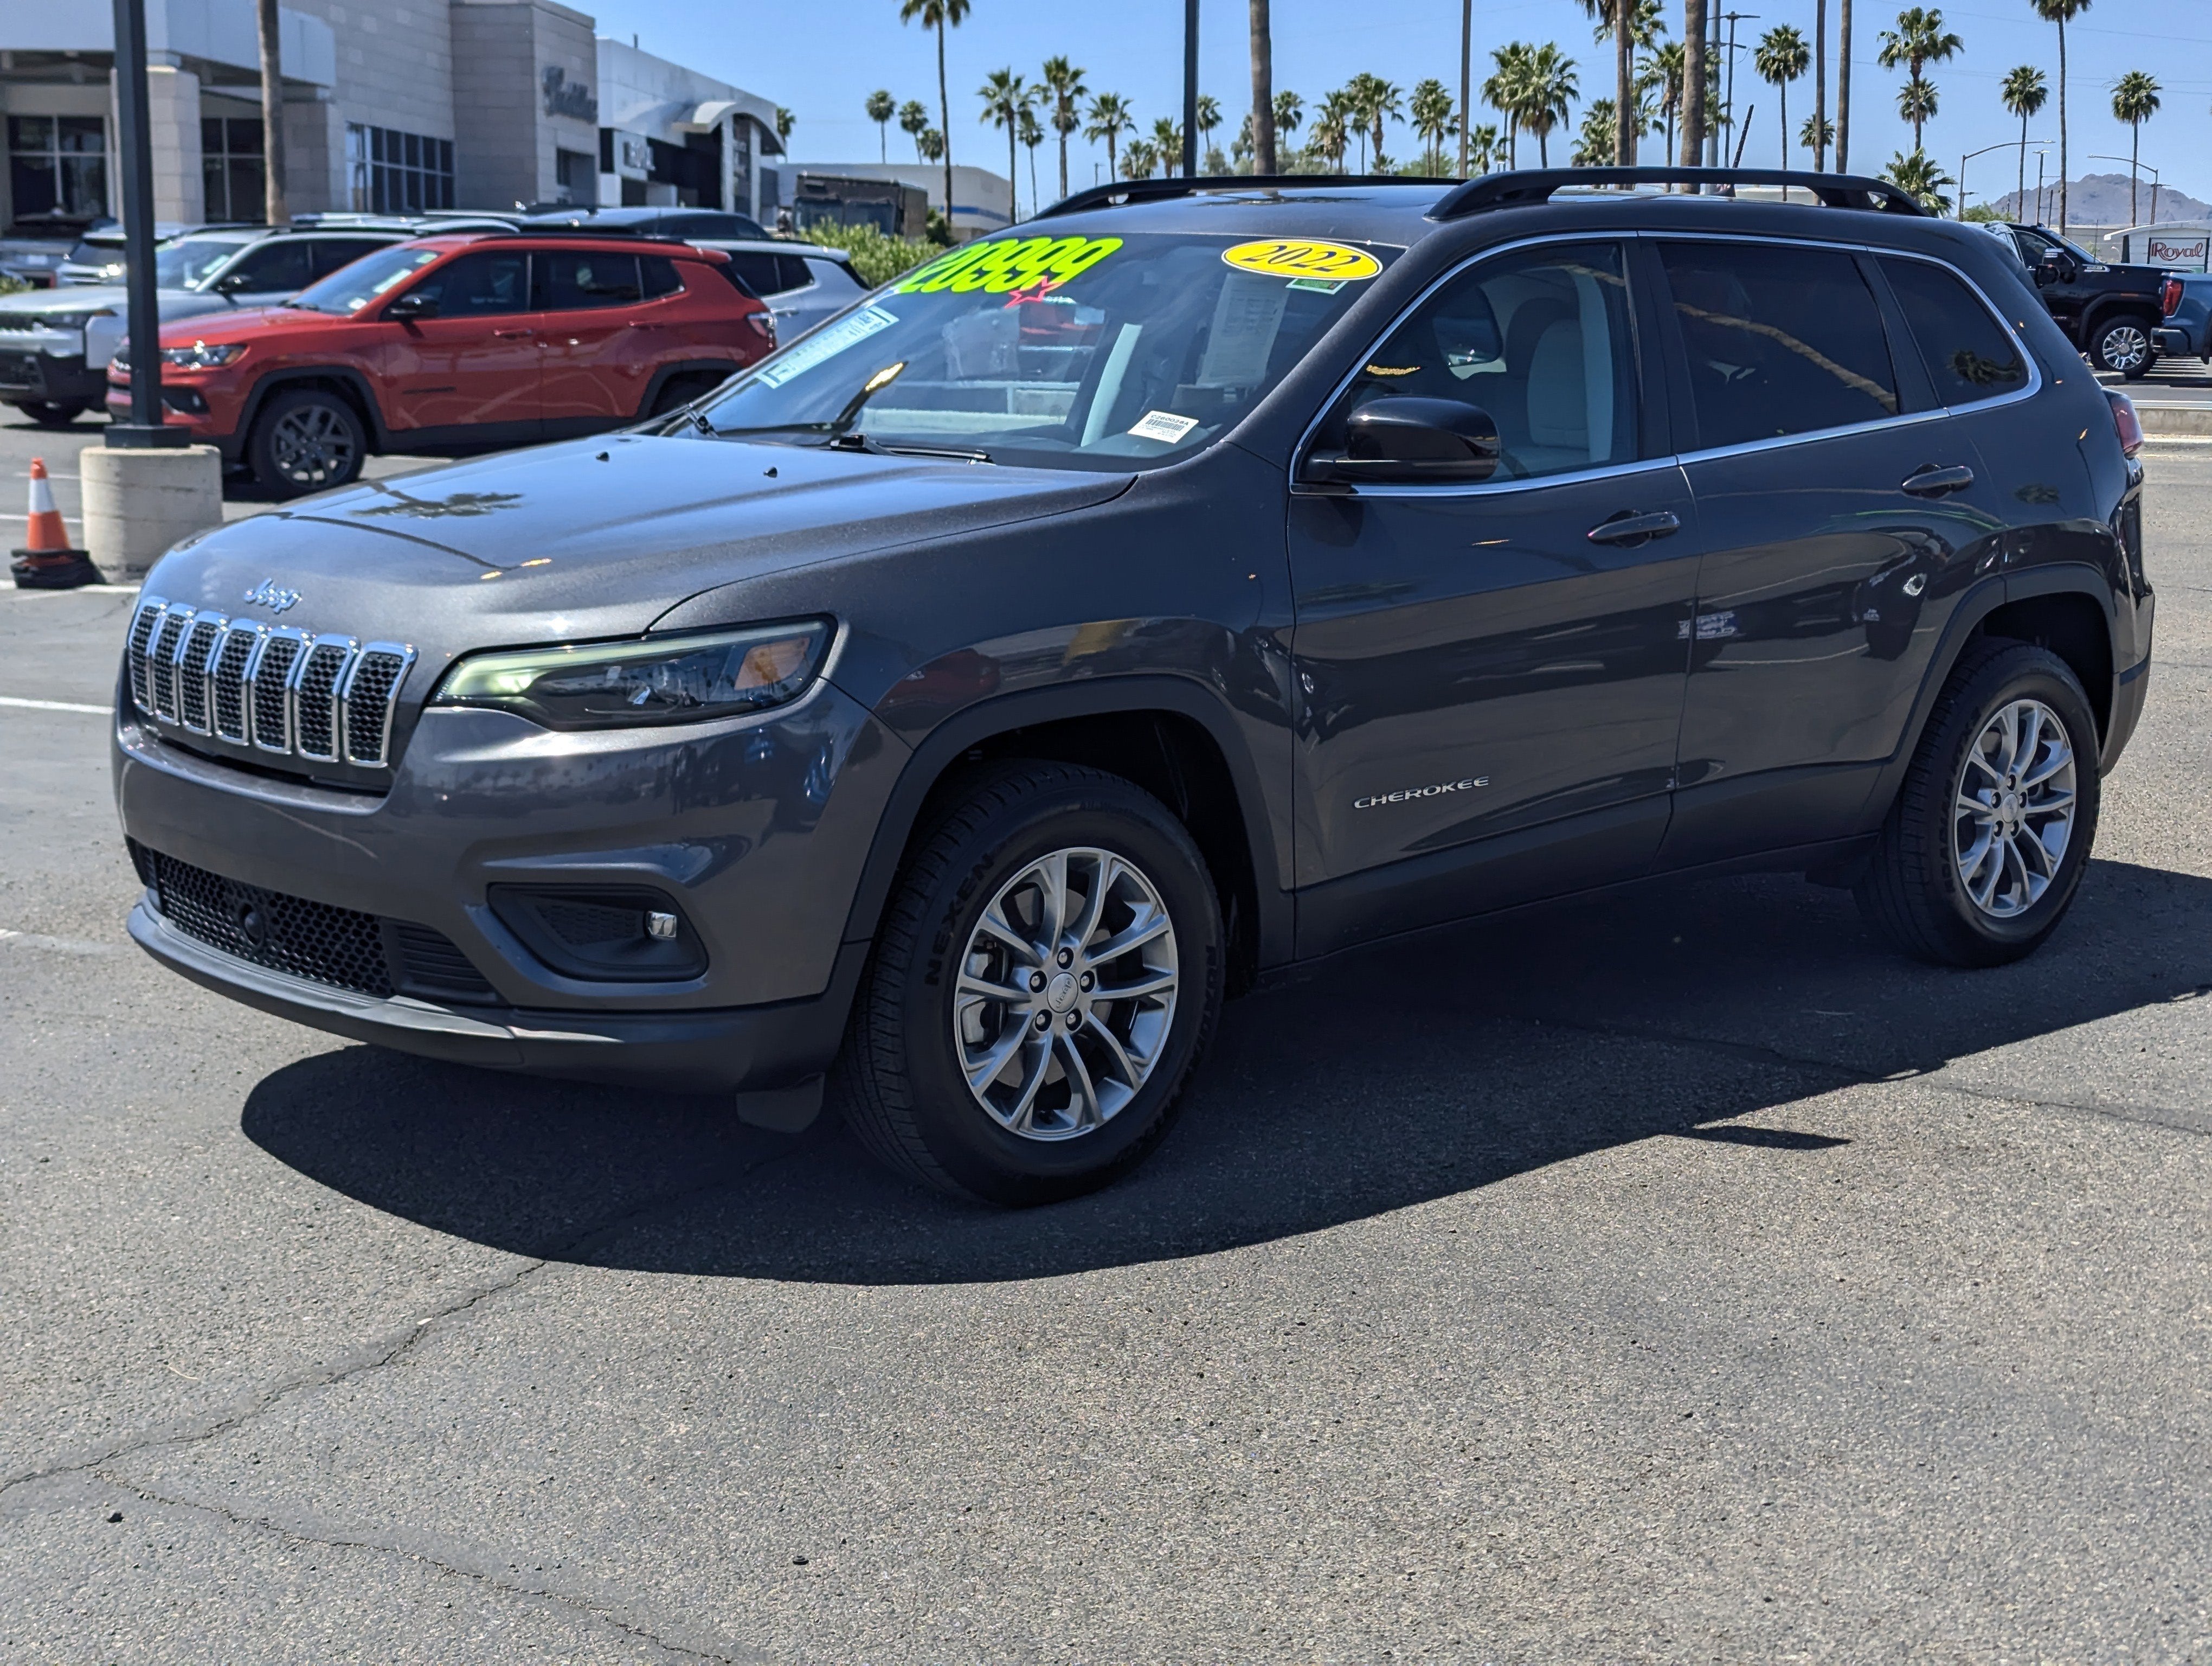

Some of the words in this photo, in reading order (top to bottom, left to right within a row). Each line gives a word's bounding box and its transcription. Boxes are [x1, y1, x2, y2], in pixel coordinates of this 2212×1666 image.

[892, 236, 1124, 293] 20999
[1241, 244, 1361, 273] 2022
[2151, 242, 2204, 261] Royal
[243, 576, 304, 615] Jeep
[1353, 776, 1490, 809] CHEROKEE
[925, 853, 995, 986] NEXEN
[1055, 977, 1072, 1010] Jeep
